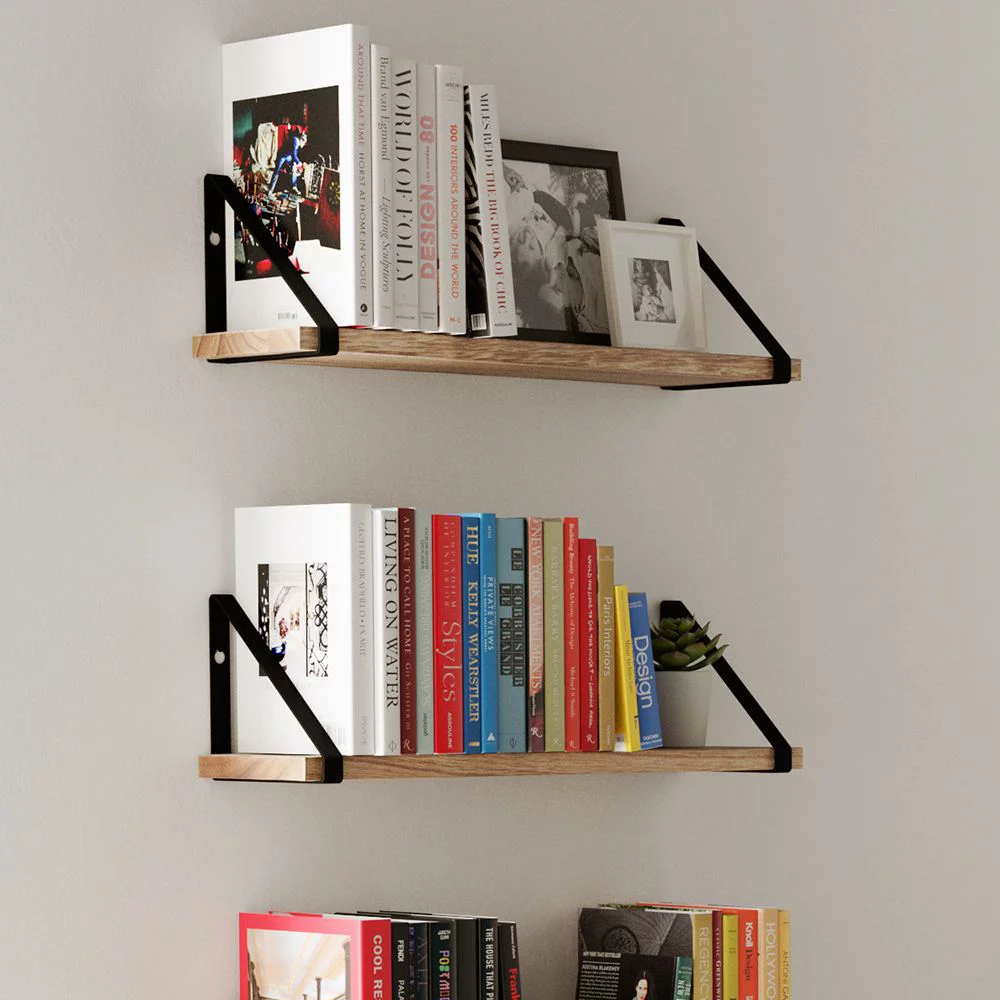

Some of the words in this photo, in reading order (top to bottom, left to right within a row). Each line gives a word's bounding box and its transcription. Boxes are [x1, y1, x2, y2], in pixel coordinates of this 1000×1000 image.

[380, 57, 390, 90] Brand
[380, 92, 388, 112] van
[395, 69, 412, 162] WORLD
[480, 93, 491, 130] MILES
[378, 116, 390, 161] Egmond
[419, 115, 435, 144] 80
[450, 123, 459, 142] 100
[483, 133, 494, 167] REDD
[396, 168, 413, 202] OF
[450, 145, 459, 194] INTERIORS
[486, 170, 497, 198] THE
[360, 190, 366, 203] AT
[488, 199, 498, 221] BIG
[379, 196, 391, 239] Lighting
[419, 183, 436, 280] DESIGN
[450, 197, 459, 240] AROUND
[360, 240, 366, 250] IN
[396, 208, 413, 282] FOLLY
[451, 243, 459, 260] THE
[491, 223, 503, 259] BOOK
[380, 241, 392, 293] Sculptures
[451, 264, 460, 299] WORLD
[494, 261, 504, 279] OF
[497, 281, 508, 314] CHIC
[403, 516, 410, 524] A
[385, 517, 397, 592] LIVING
[466, 525, 479, 565] HUE
[513, 549, 523, 570] LE
[531, 527, 541, 558] NEW
[404, 566, 411, 583] TO
[531, 563, 542, 598] YORK
[468, 581, 479, 628] KELLY
[501, 585, 511, 606] LE
[603, 597, 613, 624] Paris
[386, 600, 398, 629] ON
[404, 620, 412, 655] HOME
[501, 619, 512, 675] GRAND
[513, 585, 524, 687] CORBUSIER
[531, 602, 543, 689] APARTMENTS
[603, 628, 612, 677] Interiors
[386, 637, 399, 708] WATER
[436, 621, 462, 702] Styles
[468, 632, 480, 722] WEARSTLER
[634, 635, 653, 709] Design
[397, 940, 405, 962] FENDI
[486, 928, 494, 941] THE
[745, 922, 754, 947] Knoll
[373, 935, 383, 975] COOL
[417, 937, 428, 992] AXEL
[486, 945, 494, 969] HOUSE
[744, 950, 753, 981] Design
[486, 972, 494, 989] THAT
[677, 980, 685, 996] NEW
